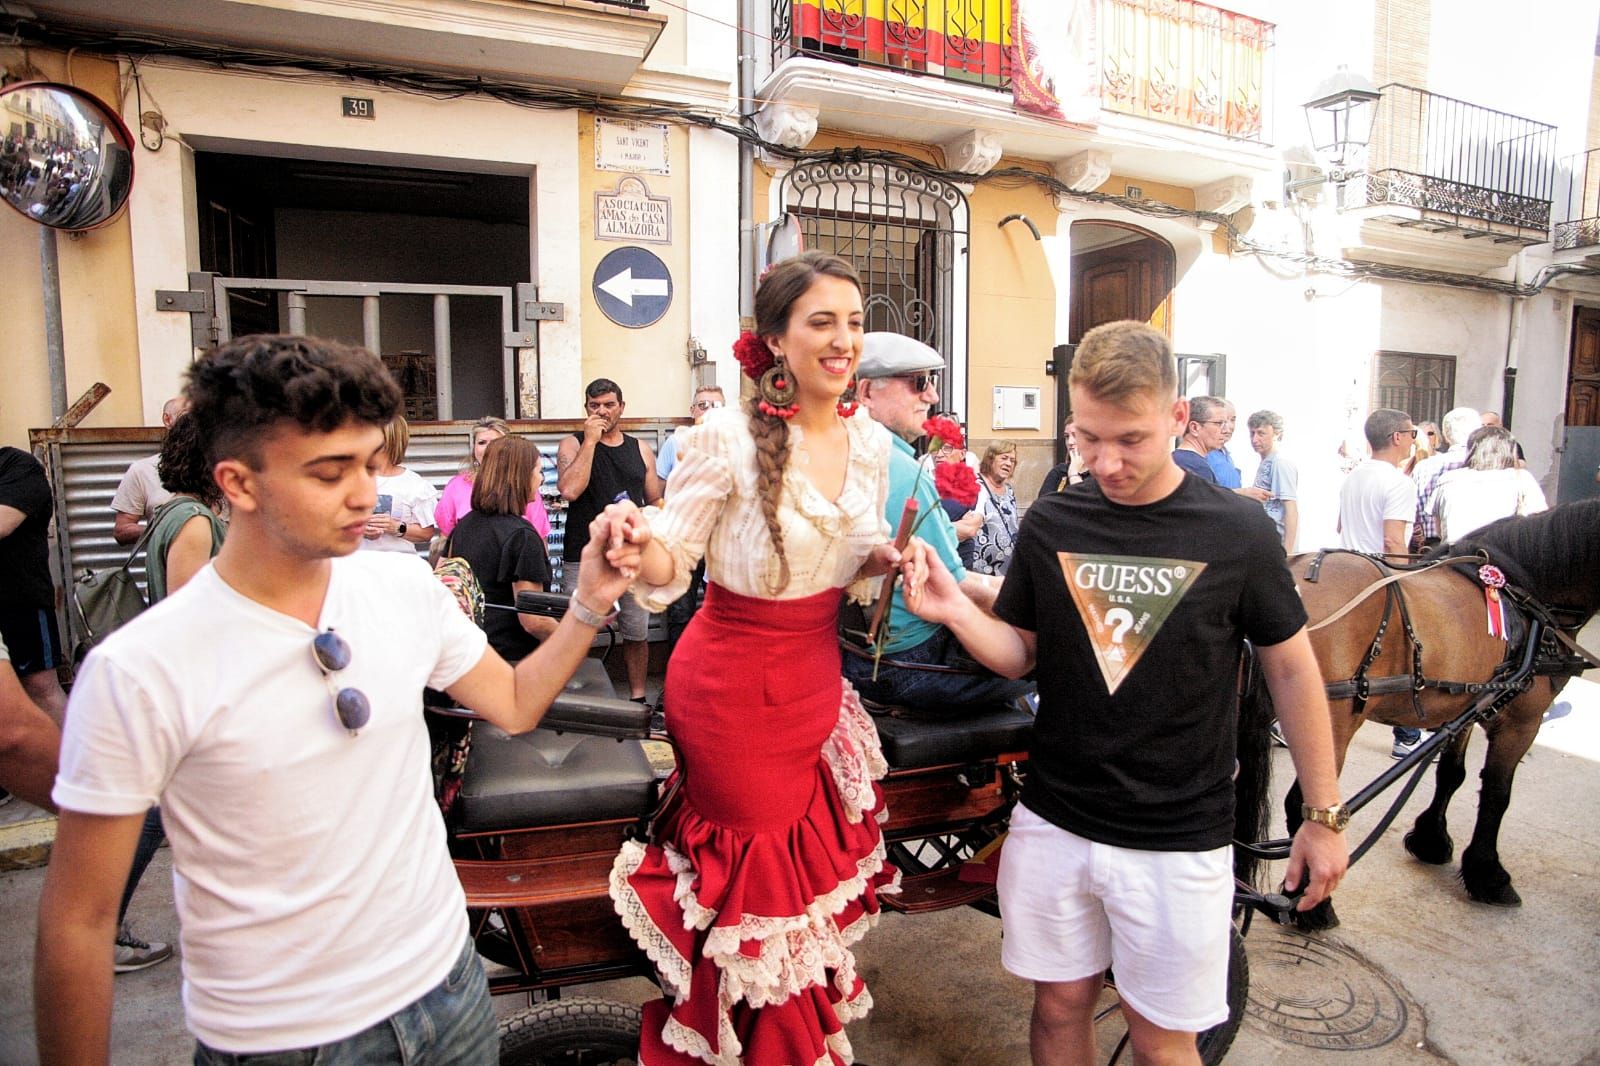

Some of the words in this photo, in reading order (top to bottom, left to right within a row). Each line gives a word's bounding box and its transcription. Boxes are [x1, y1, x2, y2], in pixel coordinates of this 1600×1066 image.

[350, 100, 367, 116] 39
[602, 199, 663, 213] ASOCIACION
[600, 209, 626, 221] AMAS
[641, 213, 665, 225] CASA
[605, 221, 660, 236] ALMAZORA
